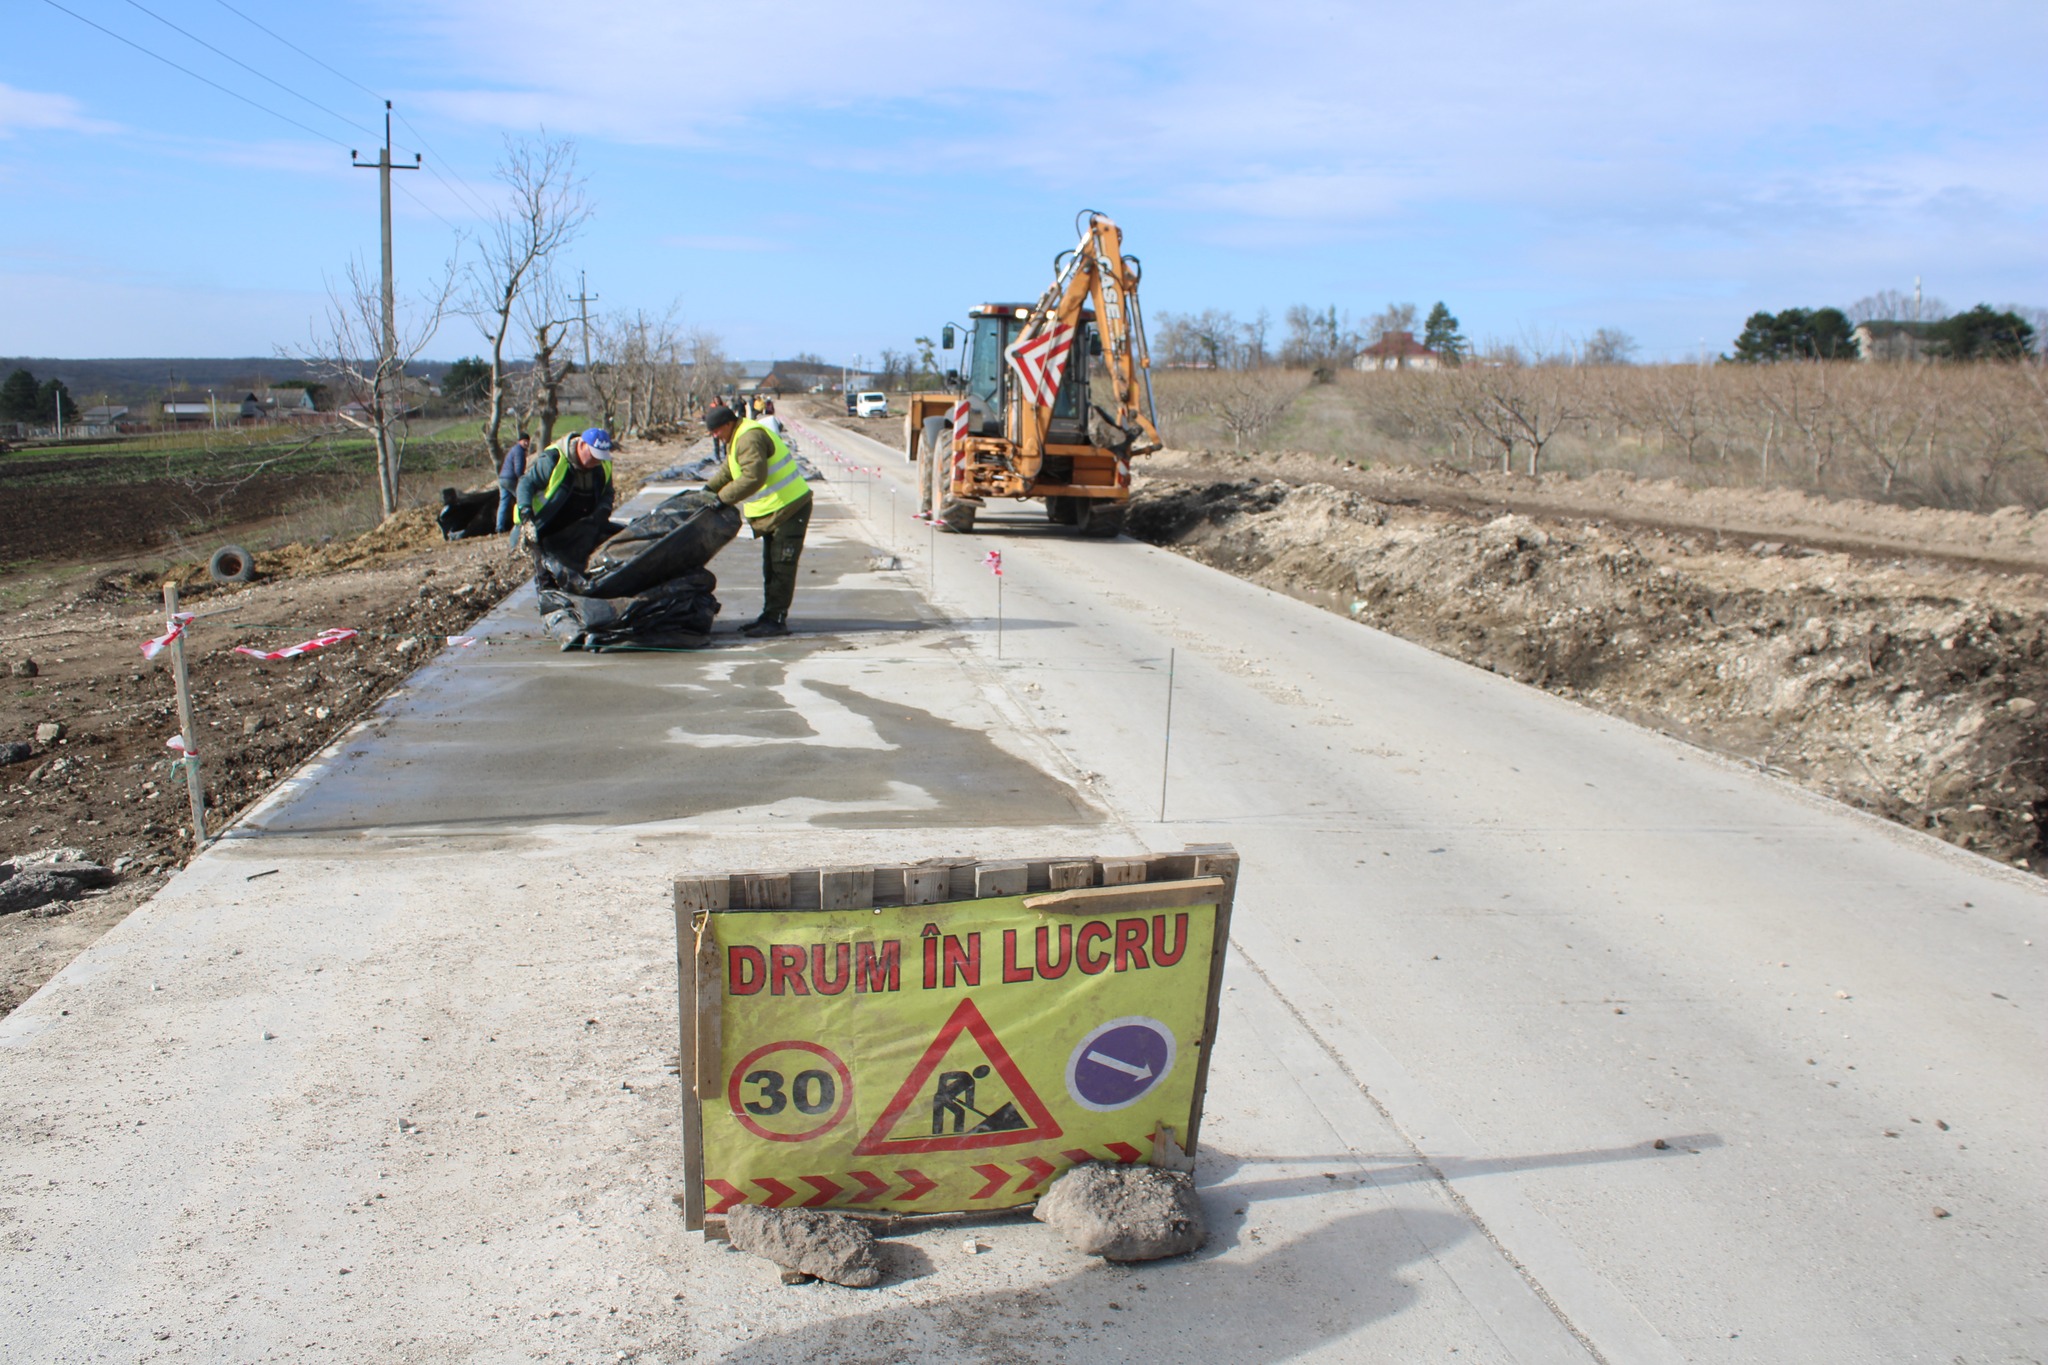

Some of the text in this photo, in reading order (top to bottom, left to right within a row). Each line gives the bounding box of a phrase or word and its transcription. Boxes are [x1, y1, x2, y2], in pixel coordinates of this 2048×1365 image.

[1097, 256, 1120, 319] CASE
[728, 913, 1189, 996] DRUM ÎN LUCRU
[744, 1069, 835, 1115] 30
